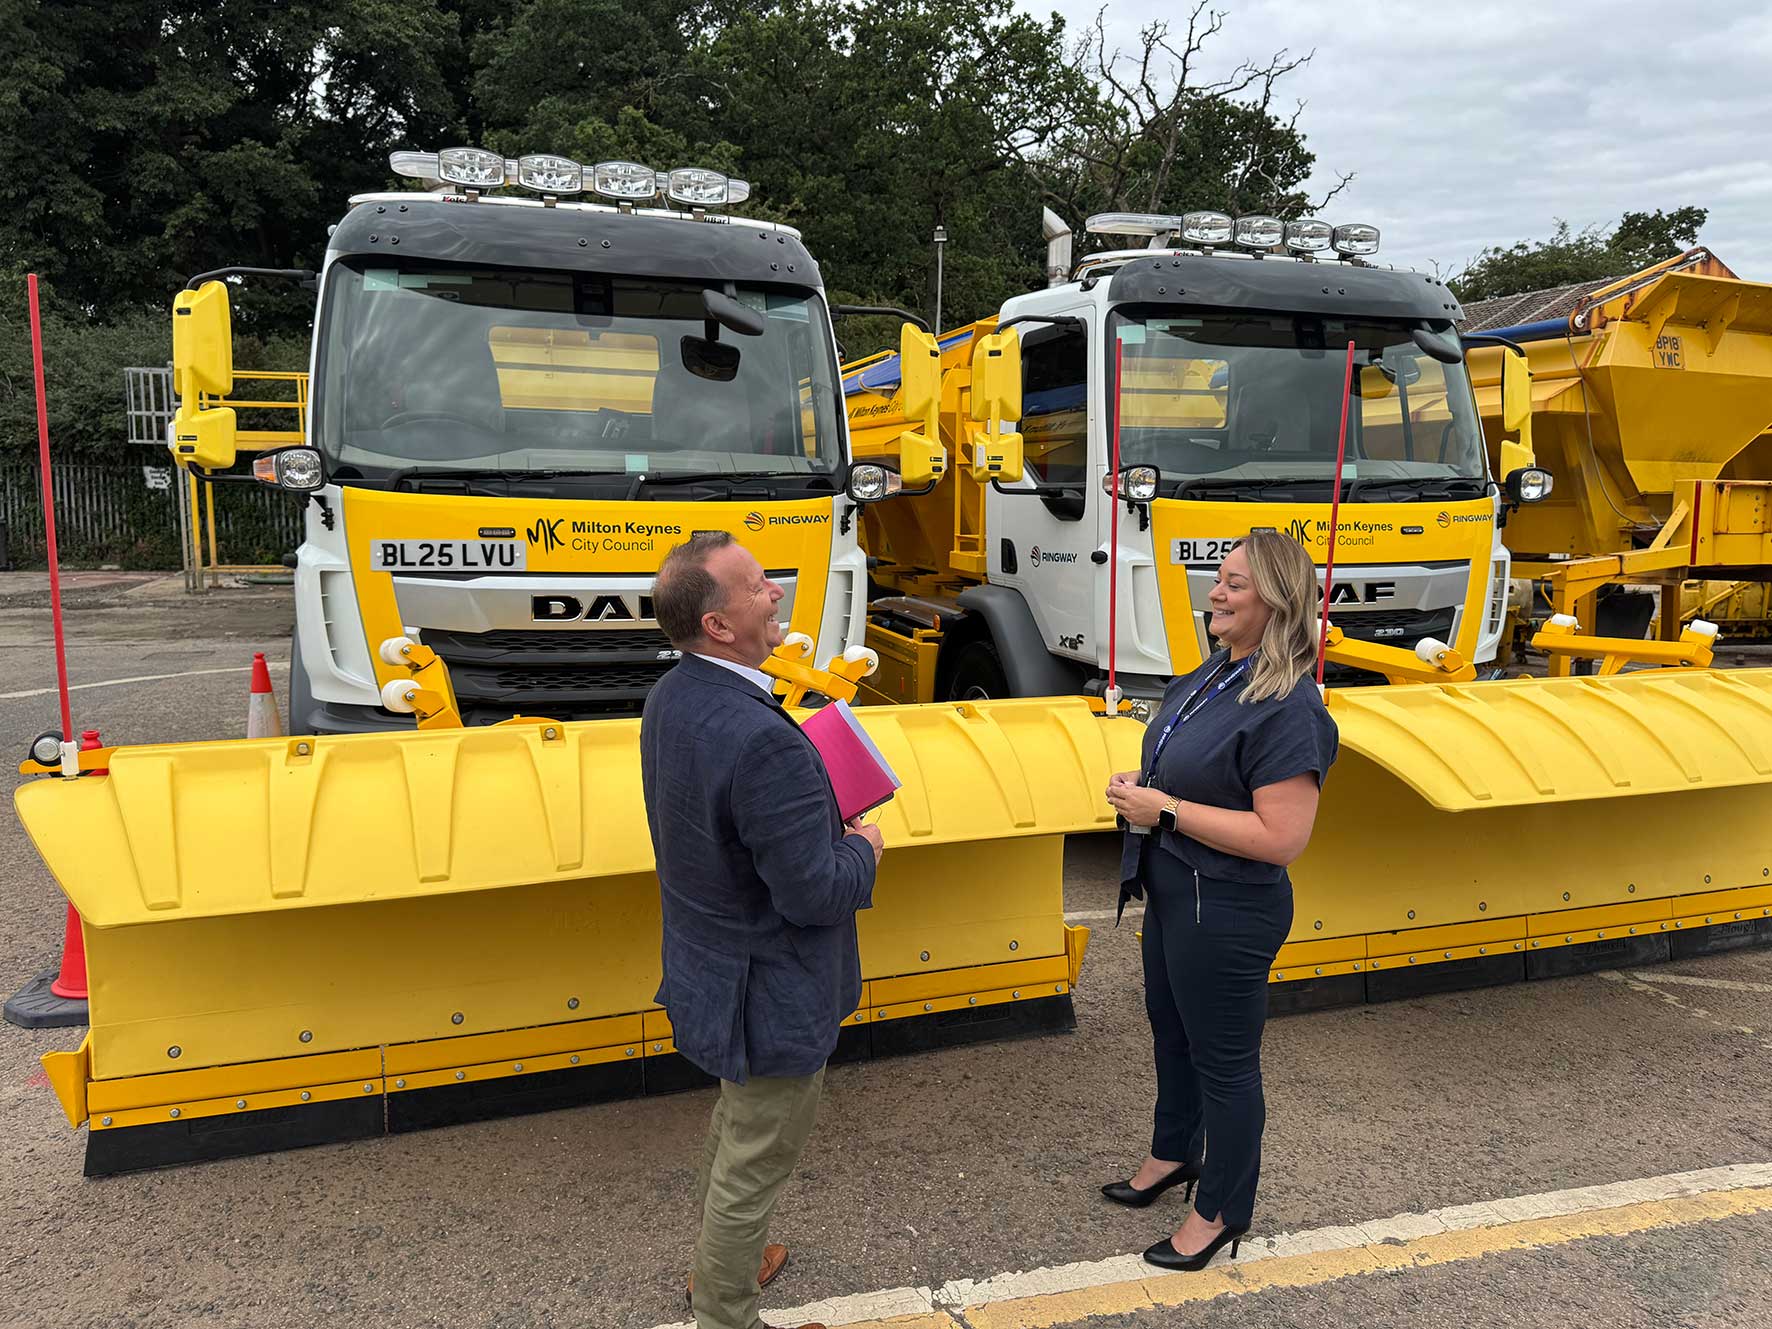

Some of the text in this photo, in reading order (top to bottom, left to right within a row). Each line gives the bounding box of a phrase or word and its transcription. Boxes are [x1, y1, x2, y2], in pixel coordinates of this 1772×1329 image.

[1659, 351, 1680, 366] YWC
[768, 514, 830, 525] RINGWAY
[1452, 514, 1493, 522] RINGWAY
[571, 521, 681, 536] Milton Keynes
[1316, 521, 1352, 531] Mion
[1353, 521, 1393, 533] Keynes
[571, 538, 654, 553] City Council
[1338, 535, 1375, 546] Council
[381, 543, 515, 566] BL25 LVU
[1042, 552, 1078, 563] RINGWAY
[1375, 628, 1404, 637] 230
